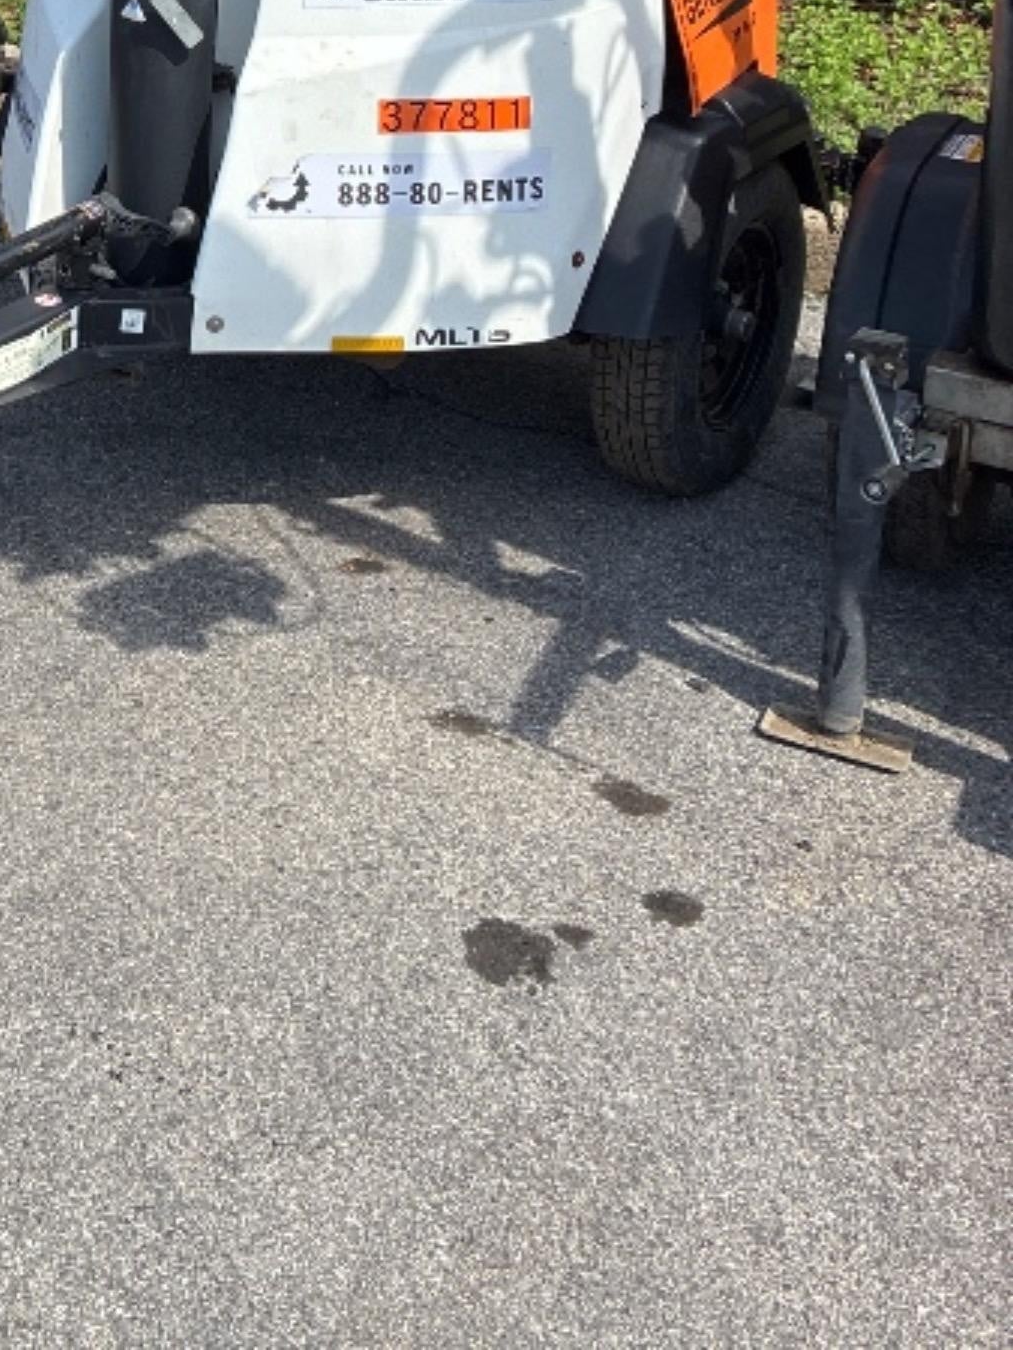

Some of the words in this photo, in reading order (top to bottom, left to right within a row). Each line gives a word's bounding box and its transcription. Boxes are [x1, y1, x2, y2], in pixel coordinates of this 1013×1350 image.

[381, 98, 521, 132] 377811
[337, 164, 373, 175] CALL
[382, 164, 415, 175] NOW
[337, 176, 544, 207] 888-80-RENTS
